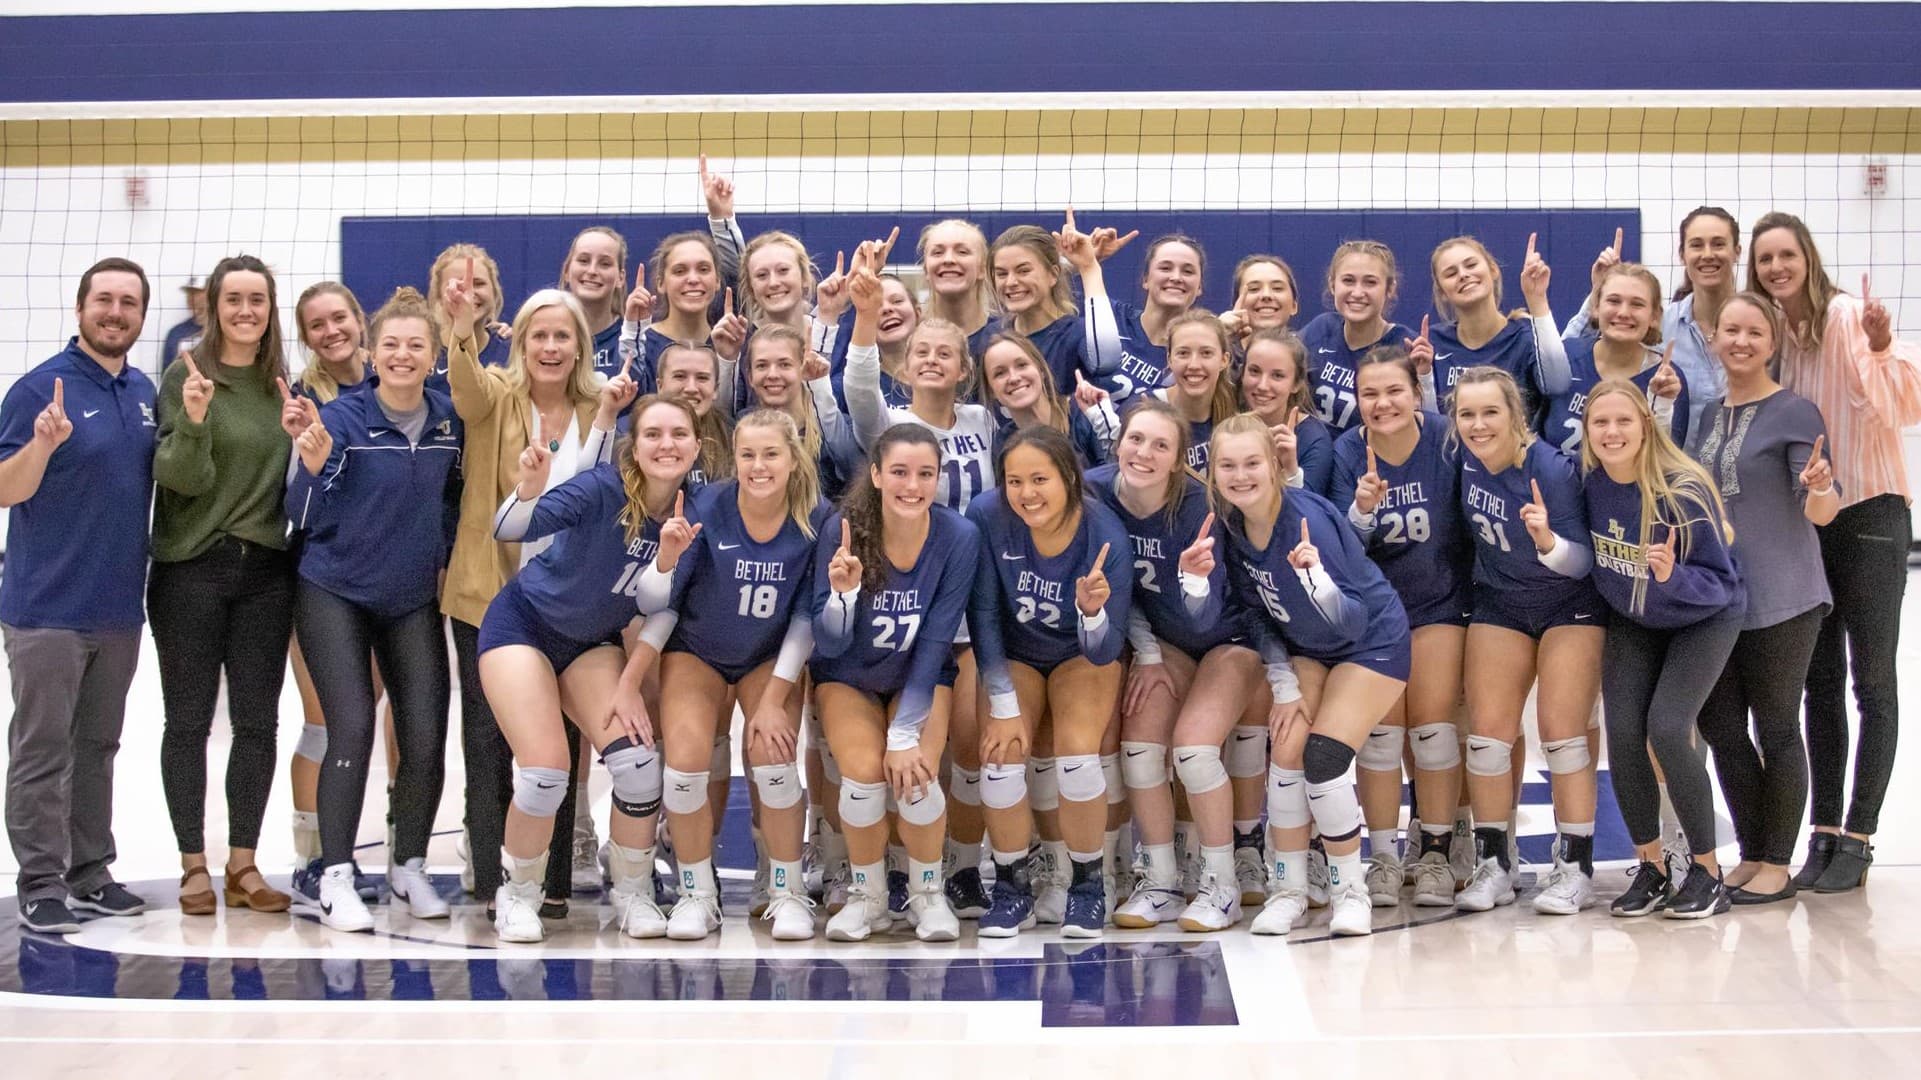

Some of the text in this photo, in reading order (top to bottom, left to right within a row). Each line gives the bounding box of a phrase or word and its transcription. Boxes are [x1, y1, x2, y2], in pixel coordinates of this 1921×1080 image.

[1320, 361, 1355, 390] BETH
[1314, 385, 1357, 429] 37
[941, 433, 987, 456] THEL
[1187, 441, 1210, 467] BET
[942, 459, 983, 509] 11
[1467, 484, 1509, 522] BETHEL
[1381, 507, 1431, 543] 28
[1472, 513, 1511, 552] 31
[626, 537, 659, 560] BETH
[1129, 534, 1166, 559] THEL
[735, 559, 787, 581] BETHEL
[1017, 570, 1064, 602] BETHEL
[1134, 559, 1161, 594] 2
[738, 584, 778, 619] 18
[872, 589, 922, 612] BETHEL
[872, 614, 921, 652] 27
